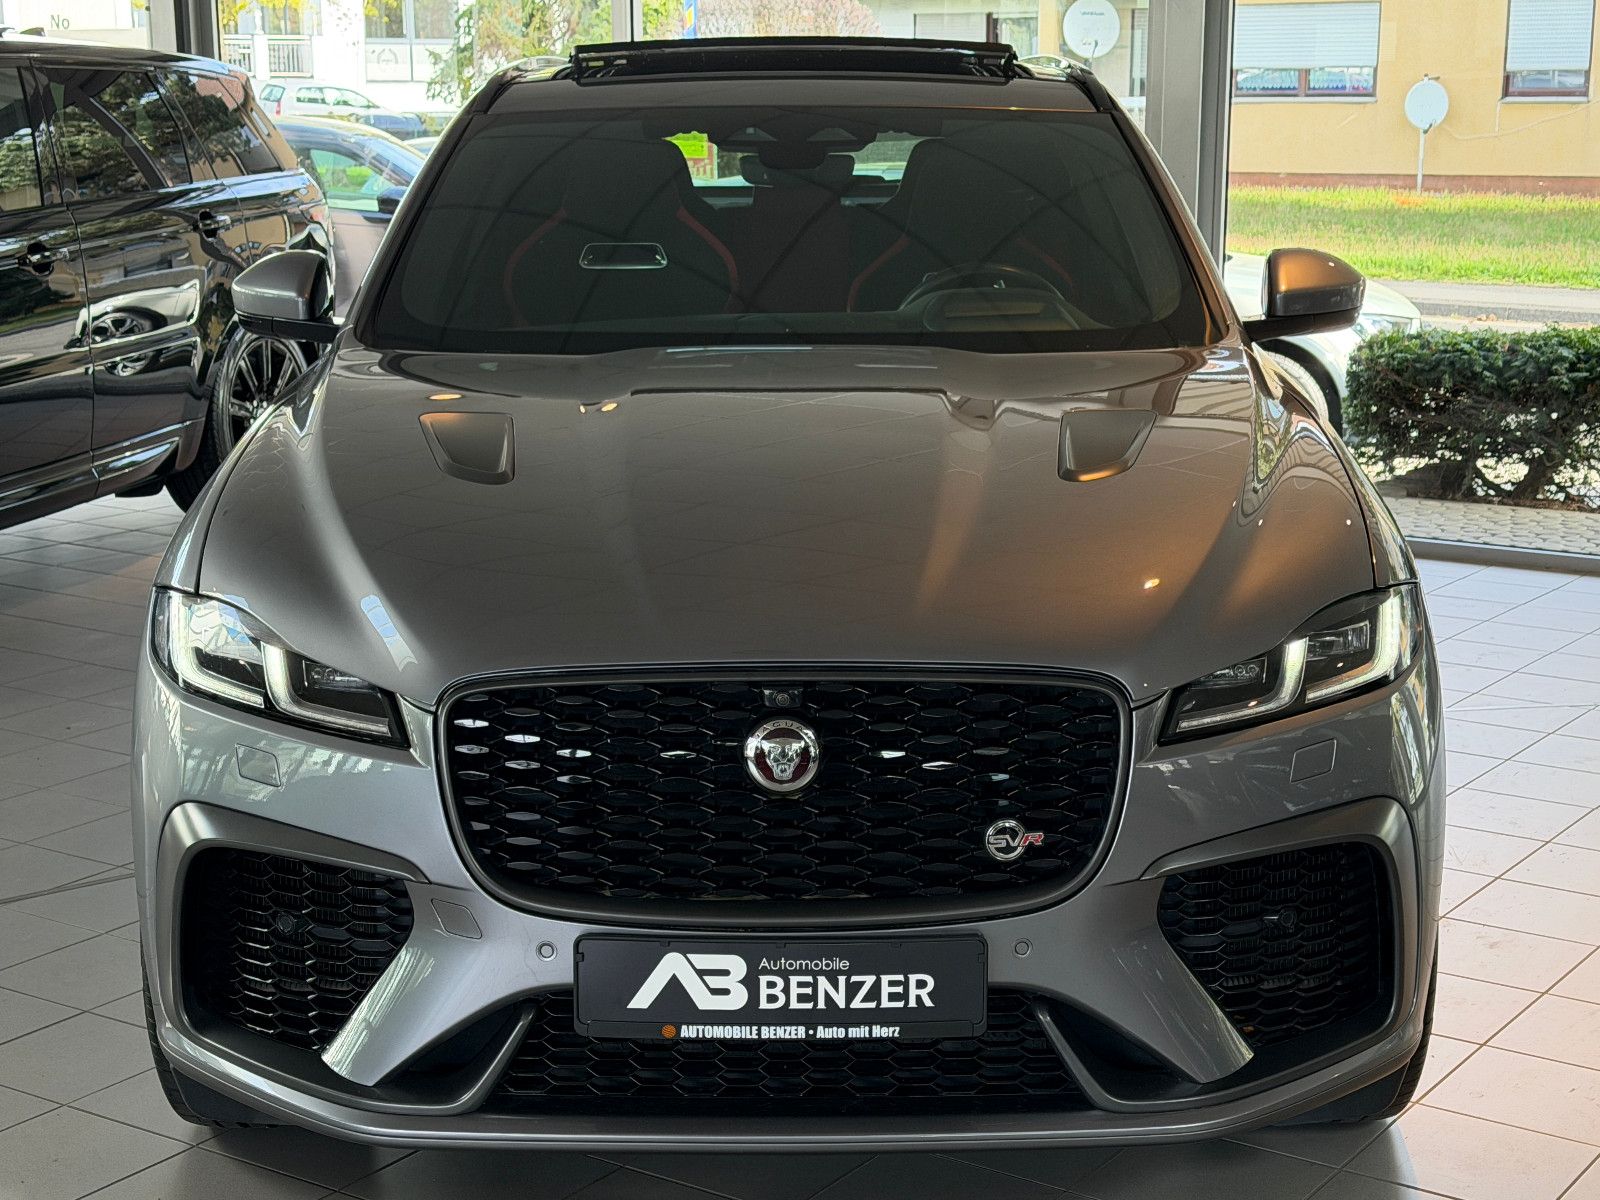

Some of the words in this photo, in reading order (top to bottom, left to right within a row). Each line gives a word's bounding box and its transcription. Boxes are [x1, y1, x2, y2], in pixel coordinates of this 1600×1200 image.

[50, 14, 70, 30] No
[758, 957, 850, 971] Automobile
[758, 973, 935, 1010] BENZER
[680, 1024, 759, 1039] AUTOMOBILE
[760, 1025, 806, 1039] BENZER
[815, 1025, 846, 1039] Auto
[847, 1025, 870, 1039] mit
[871, 1024, 900, 1038] Herz
